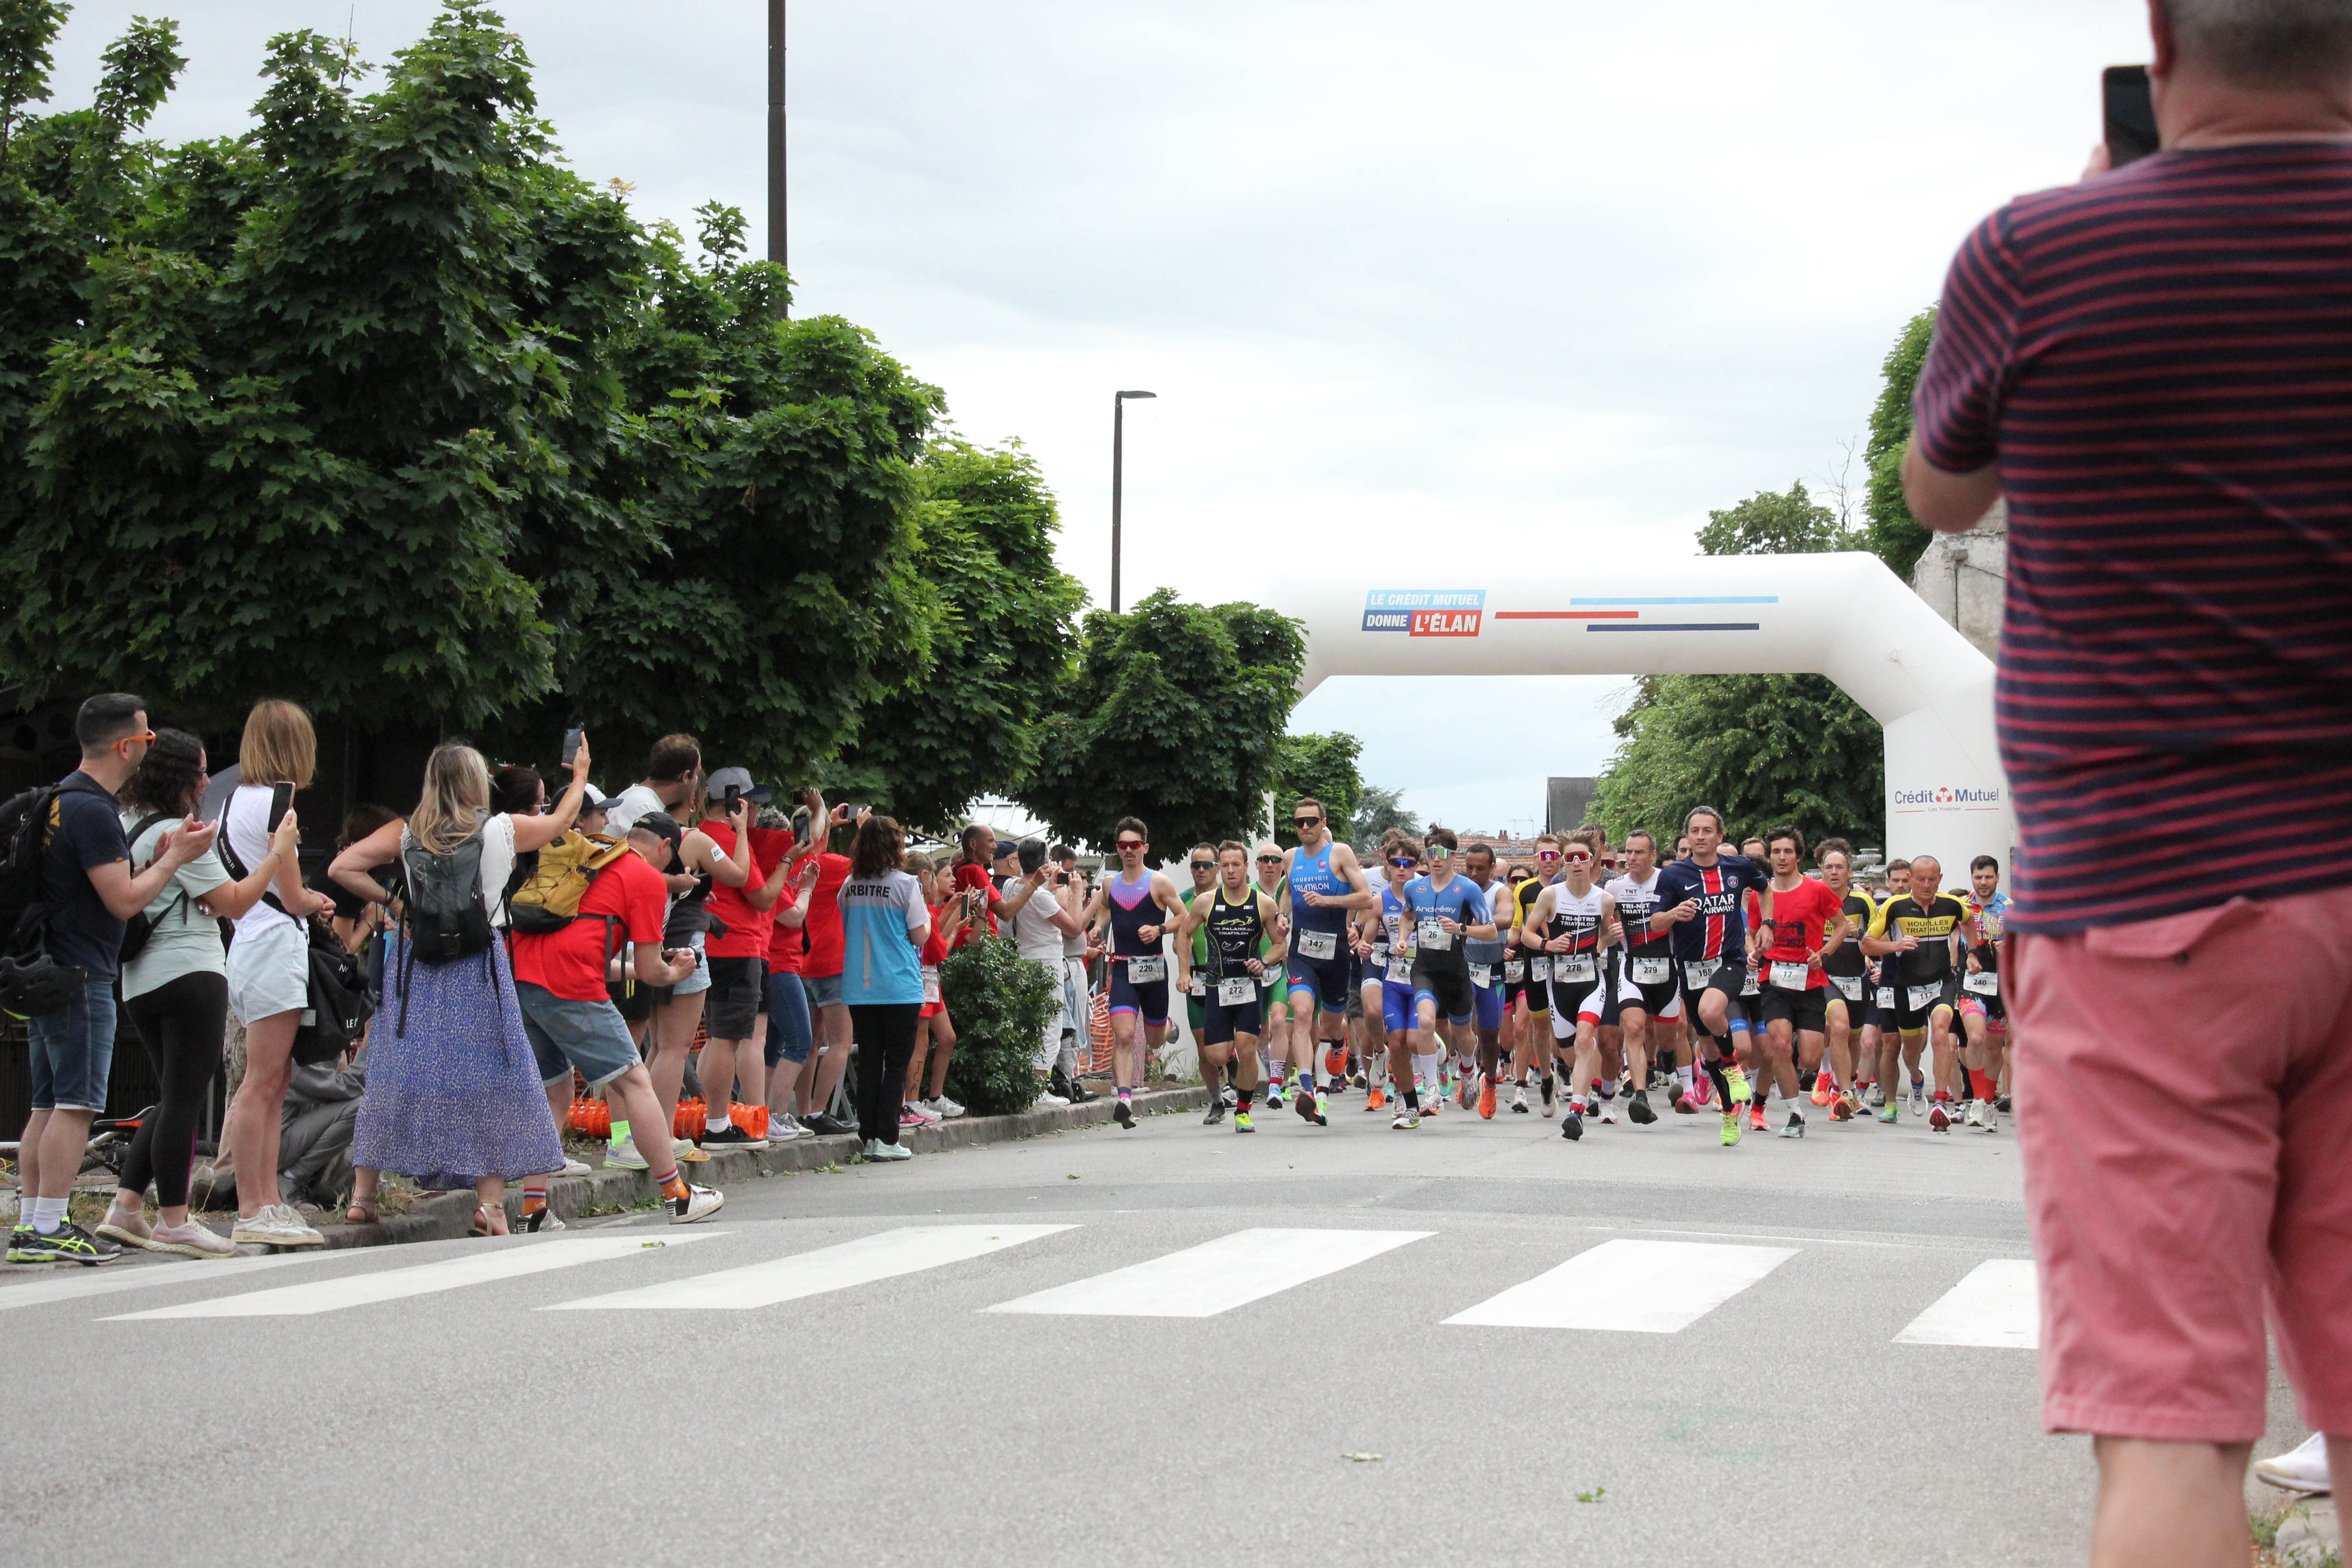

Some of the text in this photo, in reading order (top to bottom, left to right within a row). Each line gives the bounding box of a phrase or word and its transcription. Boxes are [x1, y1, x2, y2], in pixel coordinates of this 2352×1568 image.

[1370, 593, 1480, 606] LE CRÉDIT MUTUEL
[1367, 614, 1408, 627] DONNE
[1895, 788, 1999, 804] Crédit Mutuel
[845, 884, 891, 898] ARBITRE
[1293, 882, 1330, 892] TRIATHLON
[1691, 893, 1735, 911] QATAR
[1415, 905, 1456, 913] Andrésy
[1703, 905, 1735, 915] AIRWAYS
[1309, 940, 1323, 948] 147
[1786, 938, 1806, 948] 2022
[1139, 964, 1153, 973] 220
[1566, 964, 1582, 972] 278
[1698, 969, 1712, 977] 158
[1229, 986, 1243, 995] 272
[1920, 991, 1933, 1000] 117
